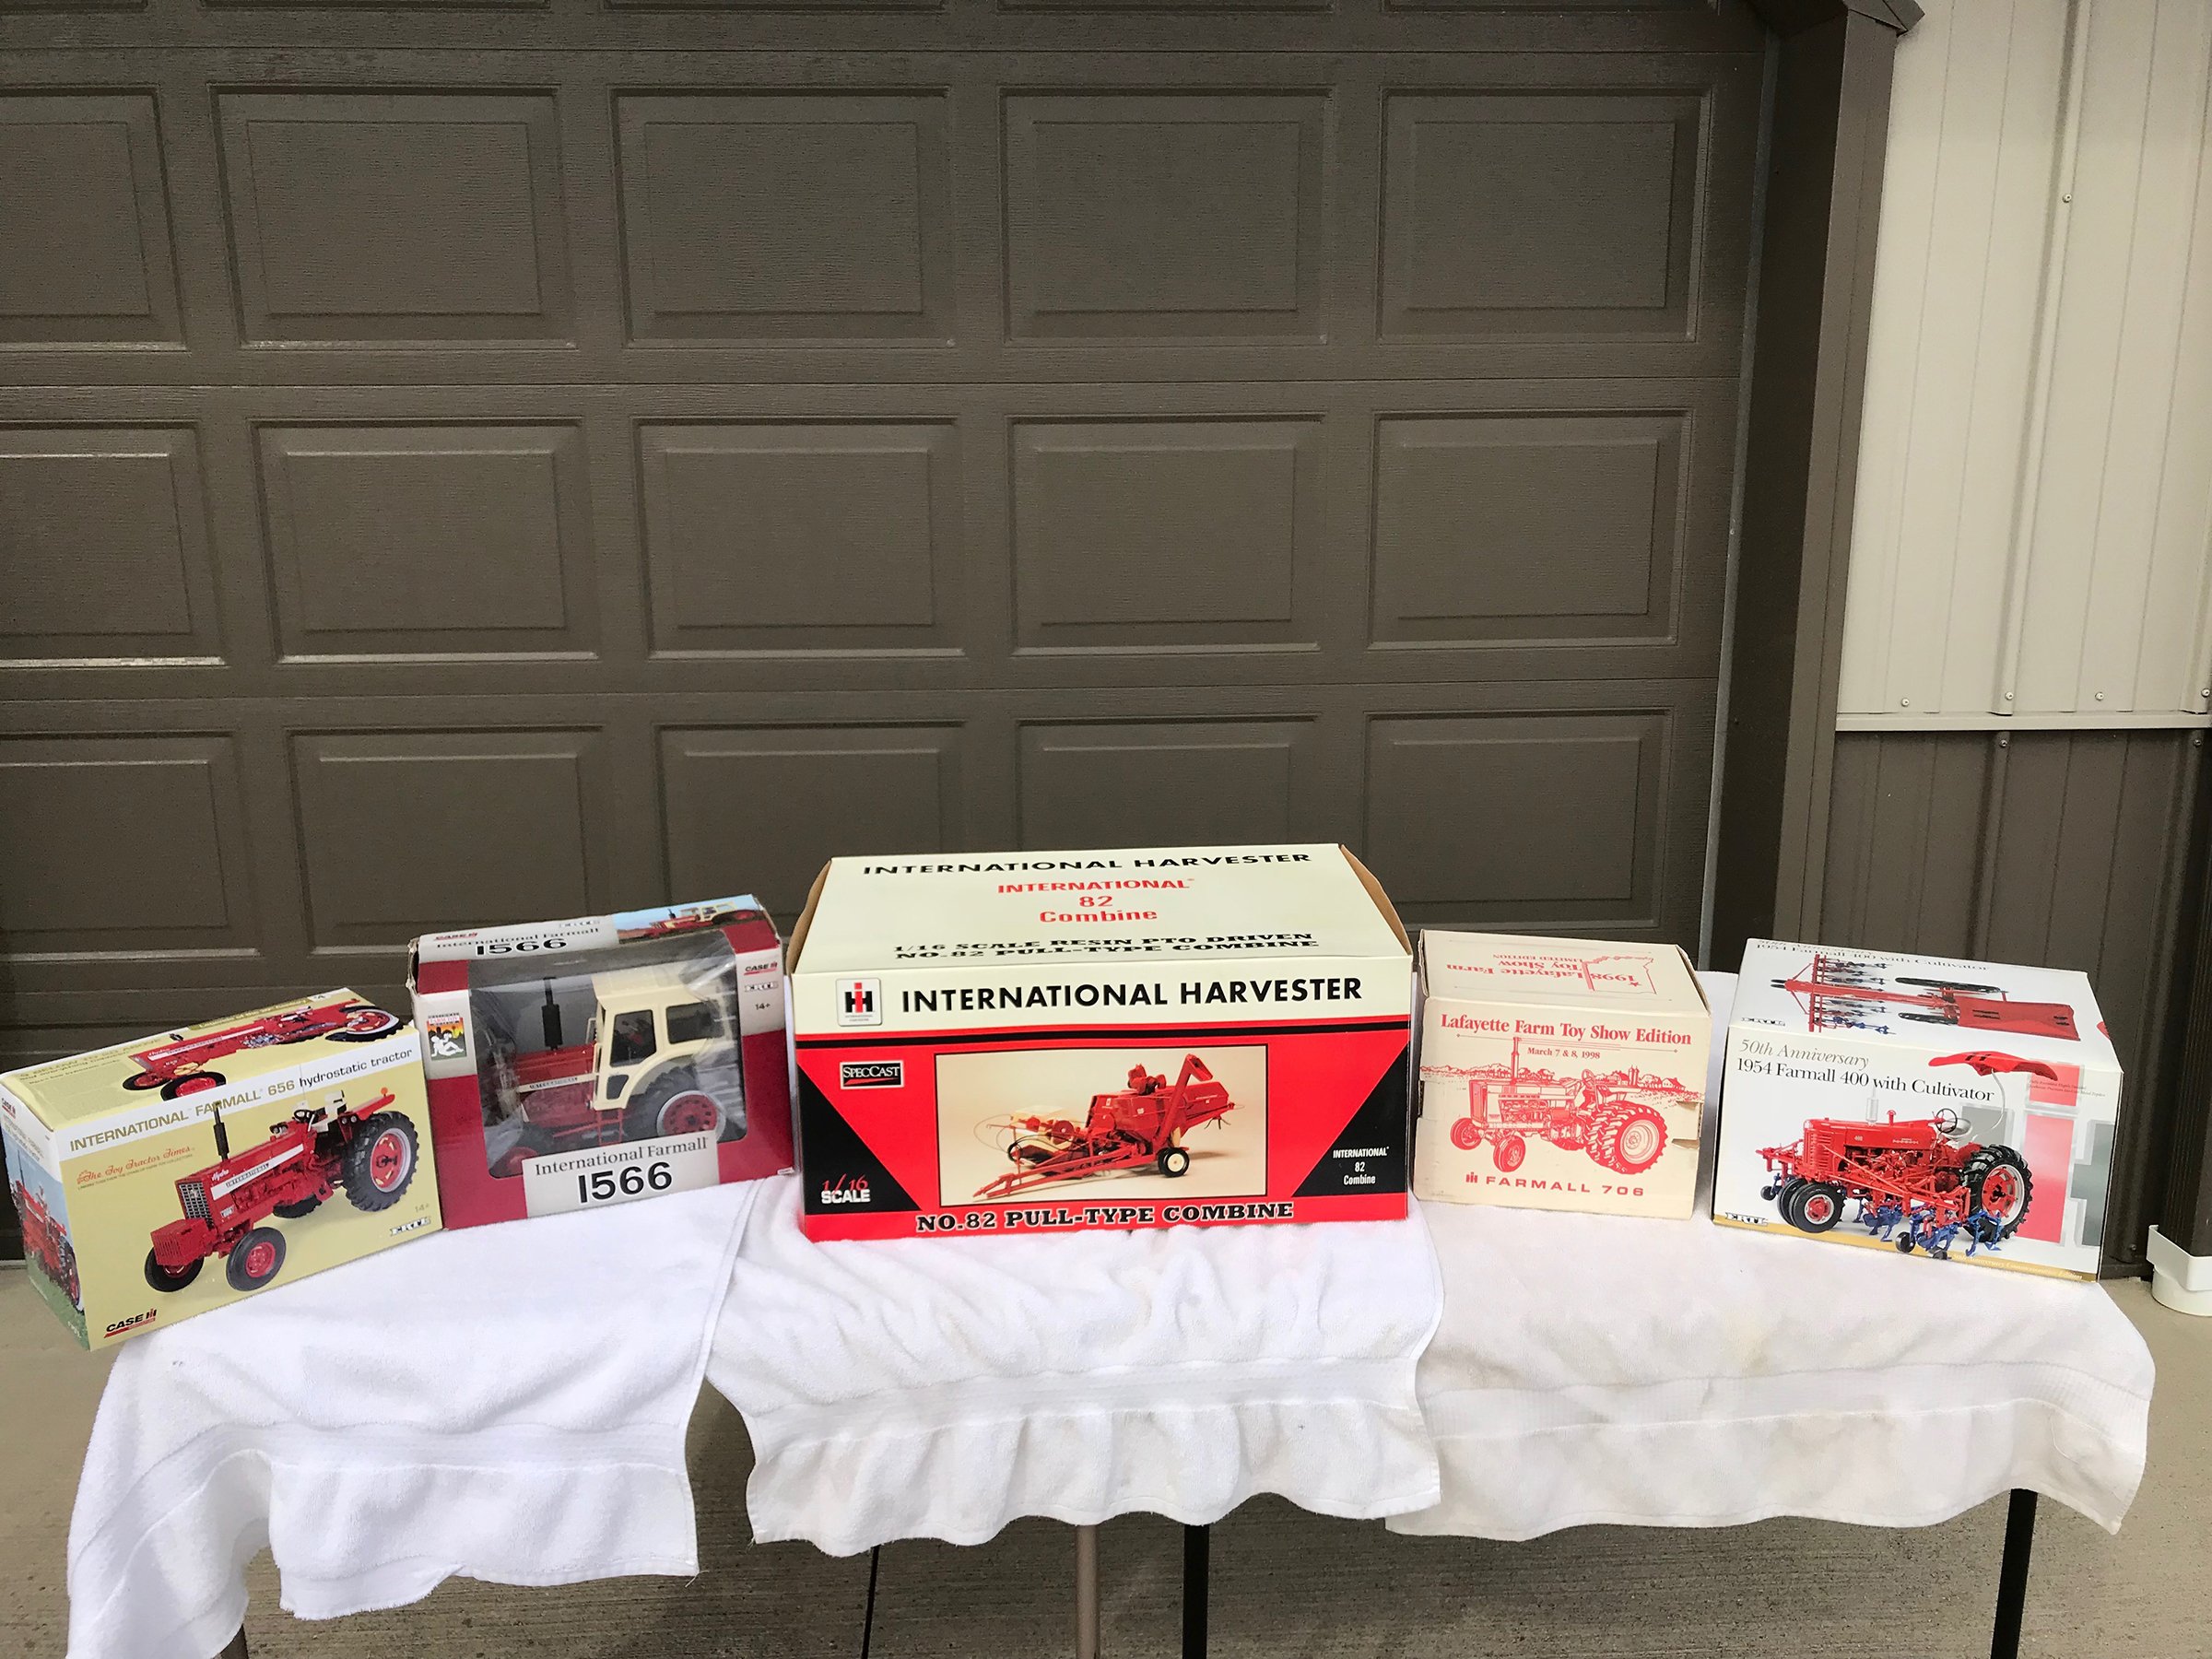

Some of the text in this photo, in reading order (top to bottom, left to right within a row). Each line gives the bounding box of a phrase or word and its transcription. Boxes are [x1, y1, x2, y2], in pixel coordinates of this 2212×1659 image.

[864, 853, 1313, 875] INTERNATIONAL HARVESTER
[996, 879, 1189, 894] INTERNATIONAL
[1078, 896, 1113, 908] 82
[1039, 909, 1159, 924] Combine
[476, 938, 568, 956] 1566
[893, 933, 1313, 952] 1/16 SCALE RESIN PTO DRIVEN
[895, 941, 1319, 959] NO.82 PULL-TYPE COMBINE
[745, 962, 770, 972] CASE
[1446, 963, 1584, 980] Lafayette Farm
[1498, 959, 1583, 972] Toy Show
[1589, 972, 1637, 982] 1998
[903, 977, 1363, 1013] INTERNATIONAL HARVESTER
[1441, 1014, 1692, 1045] Lafayette Farm Toy Show Edition
[1527, 1046, 1553, 1057] March
[1554, 1049, 1560, 1057] 7
[1562, 1050, 1571, 1058] &
[1582, 1051, 1601, 1060] 1998
[1739, 1038, 1870, 1070] 50th Anniversary
[1736, 1057, 1995, 1101] 1954 Farmall 400 with Cultivator
[70, 1110, 189, 1152] INTERNATIONAL
[195, 1091, 262, 1117] FARMALL
[267, 1079, 295, 1097] 656
[299, 1061, 368, 1088] hydrostatic
[371, 1049, 414, 1068] tractor
[105, 1164, 124, 1176] Toy
[125, 1156, 161, 1171] Tractor
[163, 1146, 191, 1159] Times
[535, 1136, 708, 1176] International Farmall
[1333, 1147, 1388, 1159] INTERNATIONAL
[1354, 1161, 1366, 1173] 82
[577, 1161, 674, 1204] 1566
[1343, 1173, 1377, 1186] Combine
[1486, 1175, 1591, 1193] FARMALL
[1602, 1184, 1644, 1196] 706
[820, 1188, 871, 1206] SCALE
[916, 1201, 1294, 1232] NO.82 PULL-TYPE COMBINE
[1724, 1211, 1770, 1227] ERTL
[106, 1313, 144, 1333] CASE
